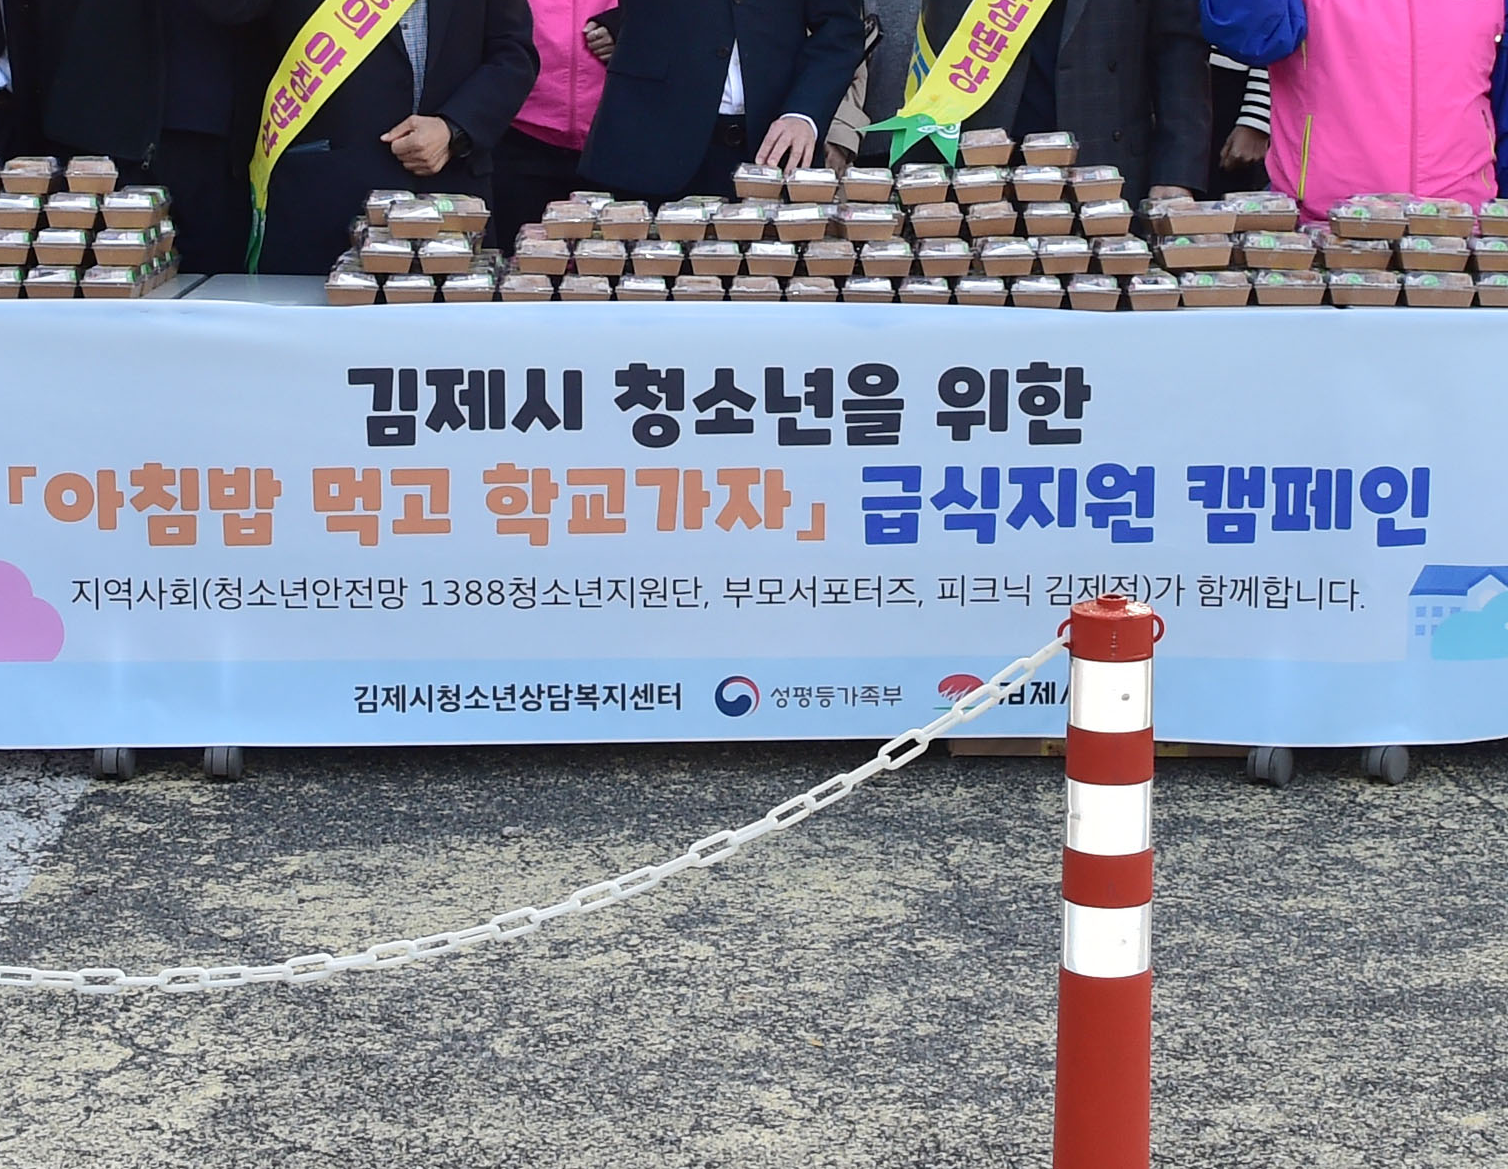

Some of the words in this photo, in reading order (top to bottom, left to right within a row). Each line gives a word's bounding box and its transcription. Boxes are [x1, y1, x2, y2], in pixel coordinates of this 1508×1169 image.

[261, 31, 348, 158] 아침밥상
[348, 367, 583, 447] 김제시
[614, 363, 905, 448] 청소년을
[936, 361, 1092, 445] 위한
[9, 463, 282, 546] 「아침밥
[313, 468, 451, 546] 먹고
[484, 463, 825, 546] 학교가자」
[862, 463, 1156, 545] 급식지원
[1187, 465, 1432, 548] 캠페인
[71, 577, 408, 611] 지역사회(청소년안전망
[421, 577, 709, 611] 1388청소년지원단,
[723, 575, 923, 610] 부모서포터즈,
[937, 574, 1030, 607] 피크닉
[1196, 575, 1365, 611] 함께합니다.
[354, 683, 682, 714] 김제시청소년상담복지센터
[770, 686, 903, 709] 성평등가족부
